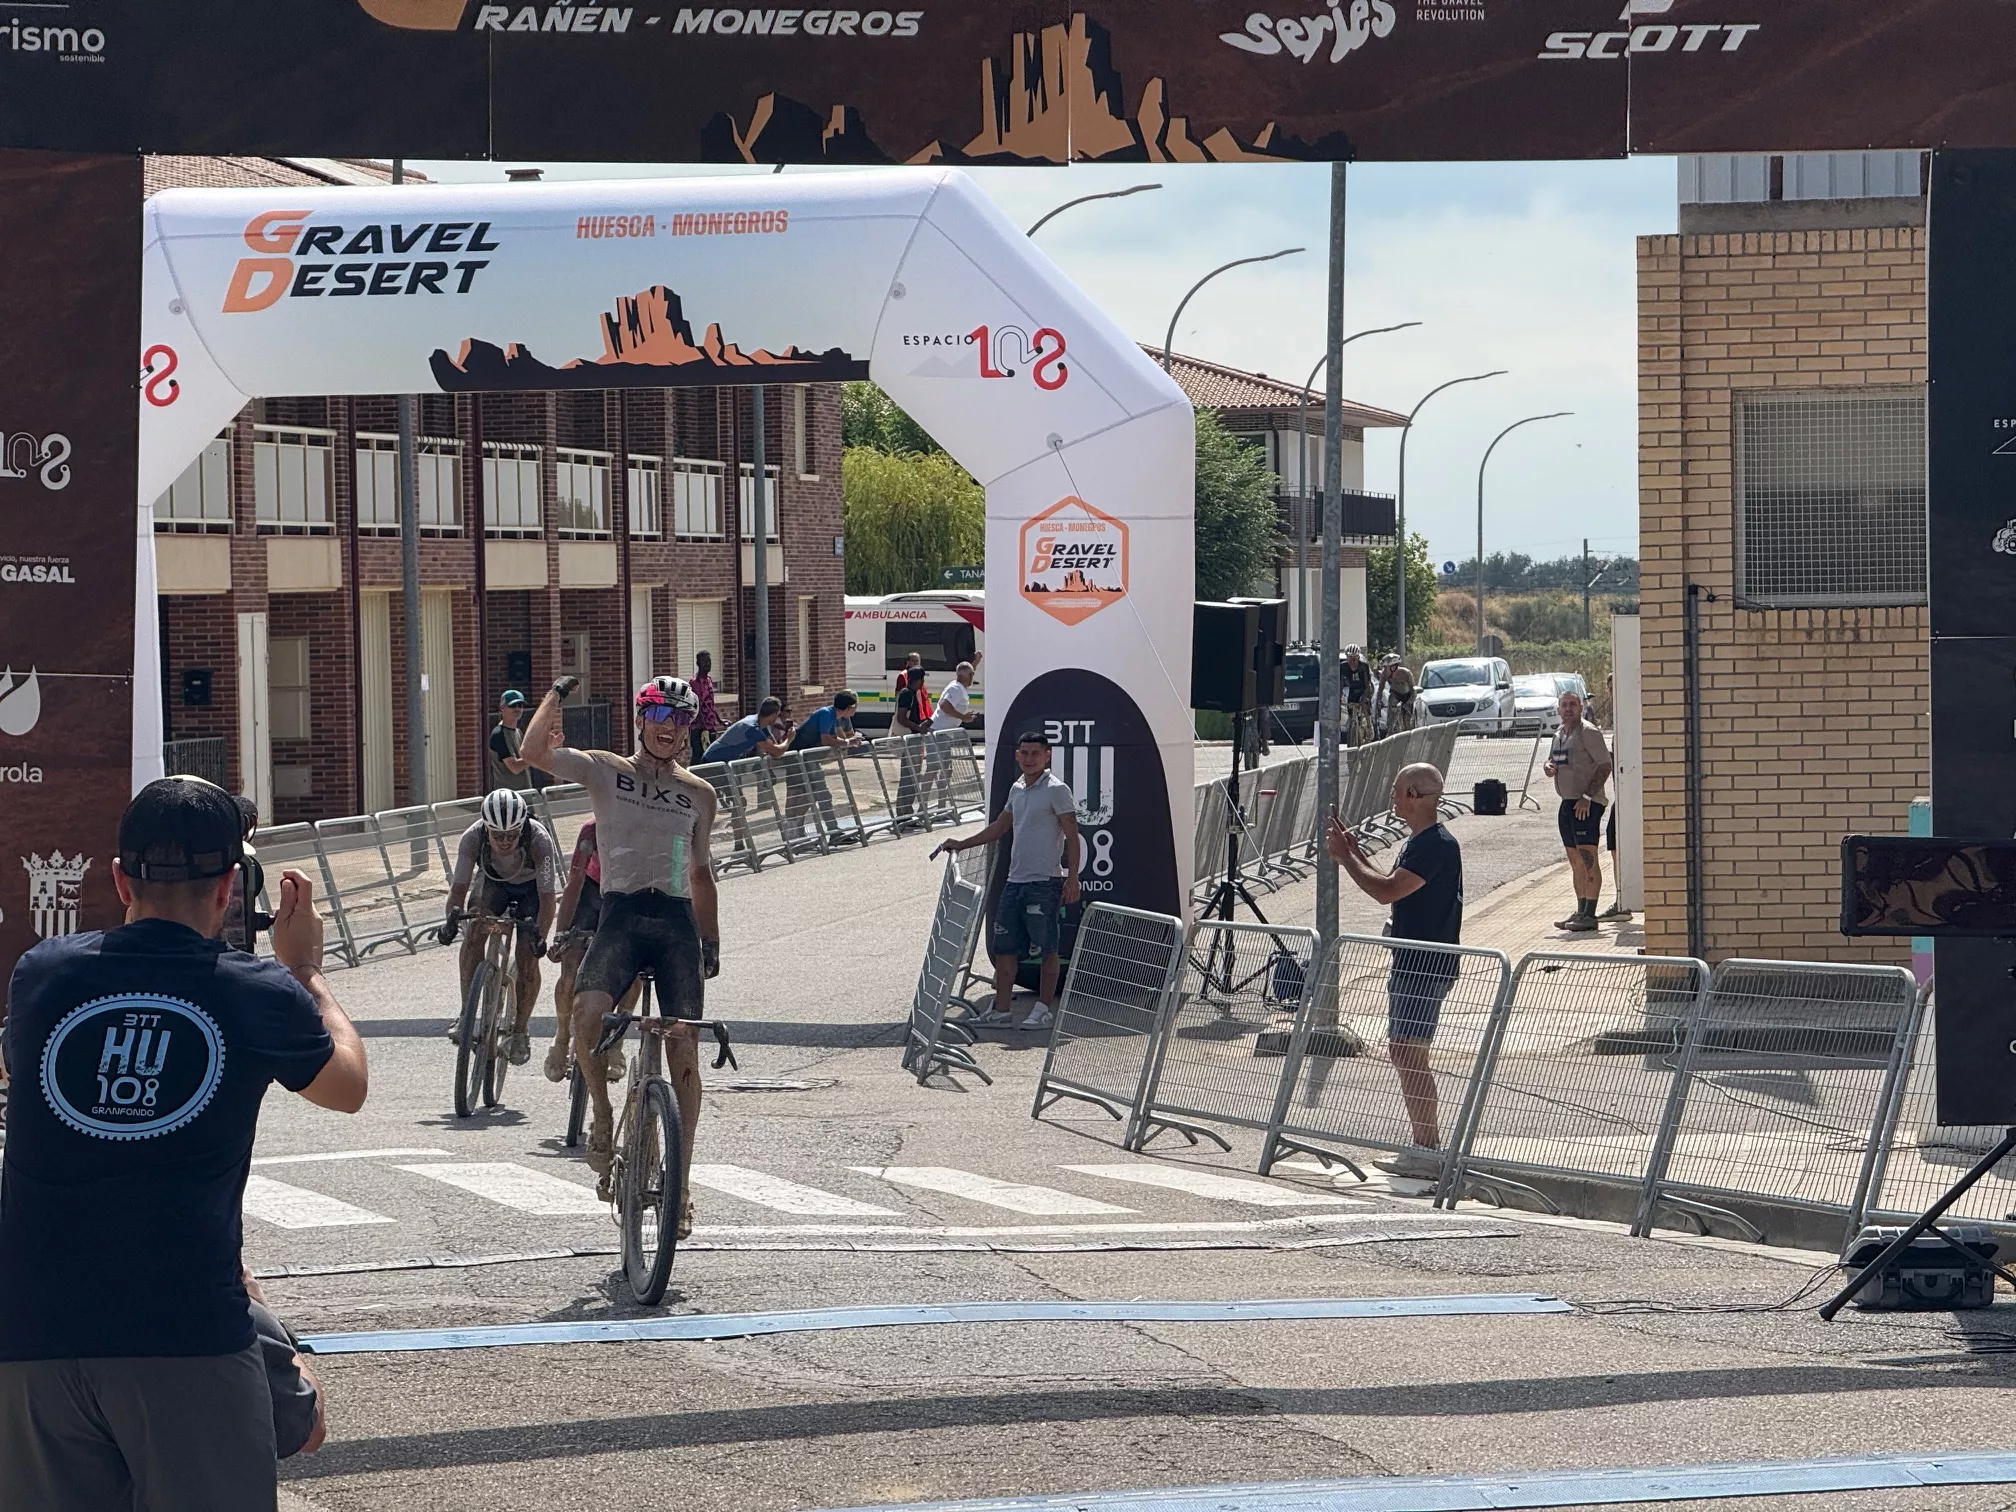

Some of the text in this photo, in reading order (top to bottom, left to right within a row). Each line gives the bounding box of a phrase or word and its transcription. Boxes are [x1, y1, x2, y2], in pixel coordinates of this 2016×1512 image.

[672, 8, 925, 37] MONEGROS
[1416, 9, 1486, 21] REVOLUTION
[1537, 23, 1762, 60] SCOTT
[60, 54, 106, 63] sostenible
[244, 209, 501, 256] GRAVEL
[576, 214, 656, 239] HUESCA
[671, 209, 789, 237] MONEGROS
[221, 257, 491, 314] DESERT
[903, 324, 1069, 391] ESPACIO 108
[1040, 522, 1064, 533] HUESCA
[1035, 536, 1118, 556] GRAVEL
[47, 556, 70, 564] fuerza
[1030, 555, 1115, 574] DESERT
[1, 563, 76, 583] GASAL
[854, 610, 928, 620] AMBULANCIA
[847, 641, 876, 655] Roja
[1044, 720, 1096, 744] BTT
[616, 772, 692, 809] BIXS
[123, 1013, 162, 1028] BTT
[97, 1026, 172, 1076] HU
[96, 1073, 160, 1107] 108
[91, 1105, 155, 1117] GRANFONDO
